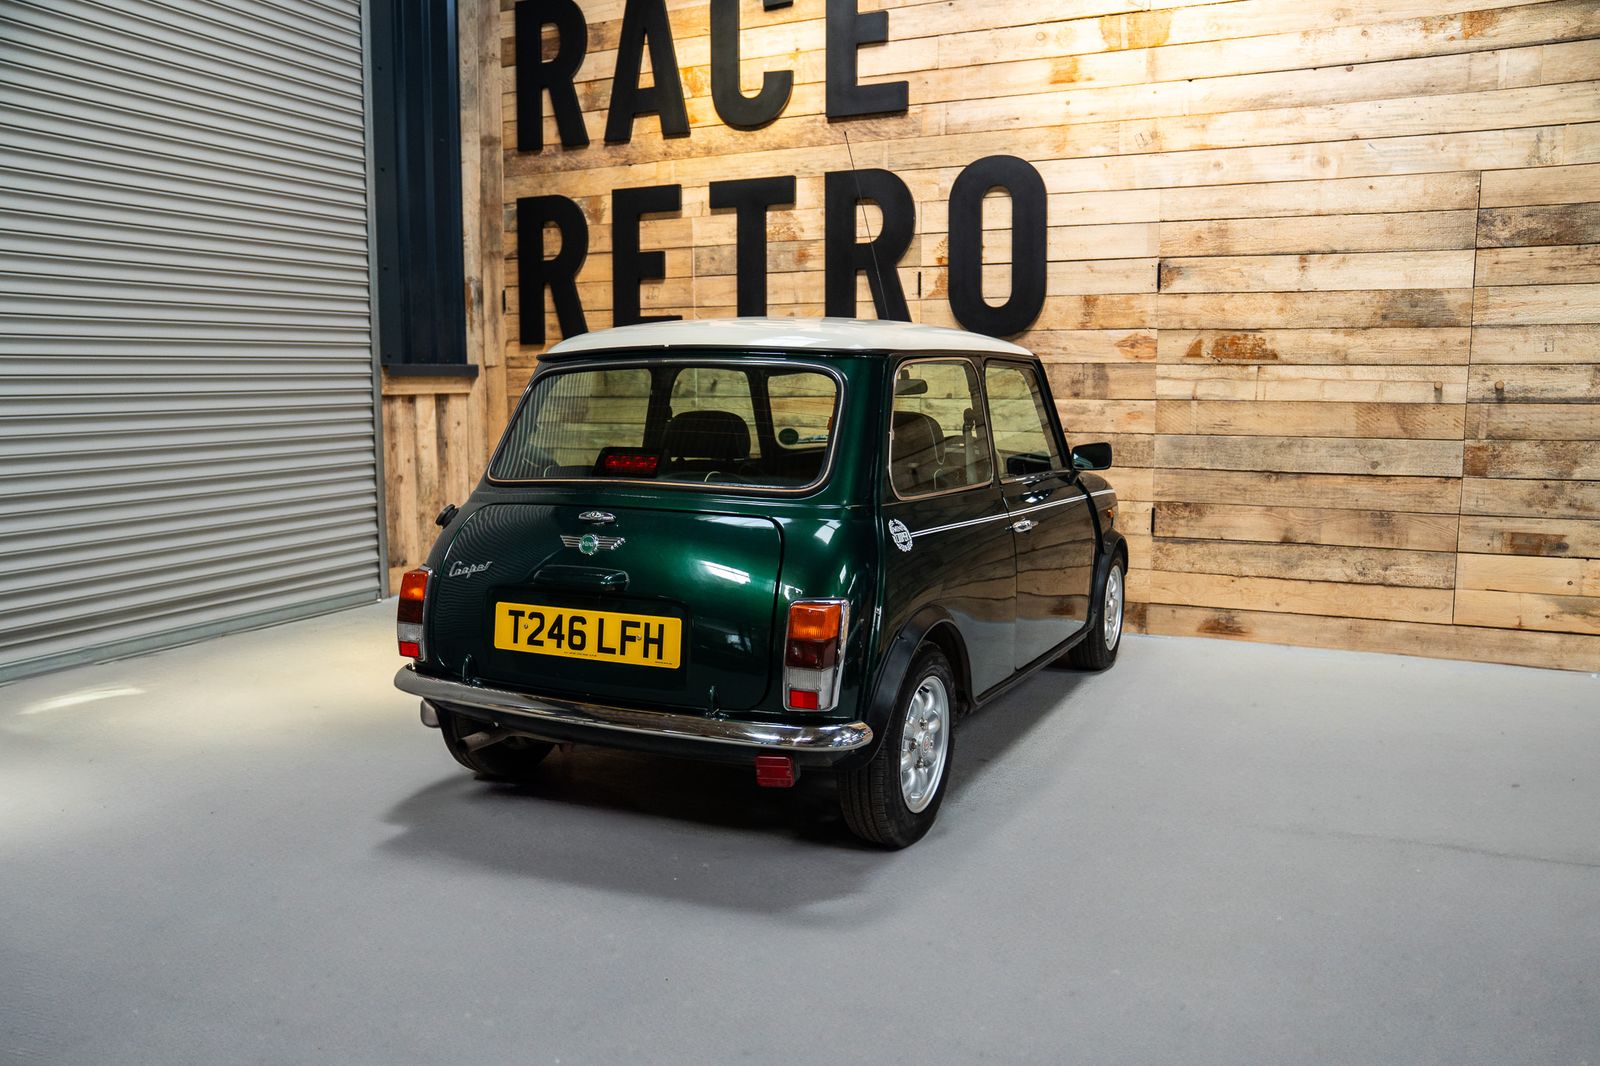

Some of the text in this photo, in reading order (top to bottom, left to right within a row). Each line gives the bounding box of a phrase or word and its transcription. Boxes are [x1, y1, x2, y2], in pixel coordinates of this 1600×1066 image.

[515, 0, 909, 152] RACE
[515, 154, 1048, 344] RETRO
[508, 610, 665, 660] T246 LFH
